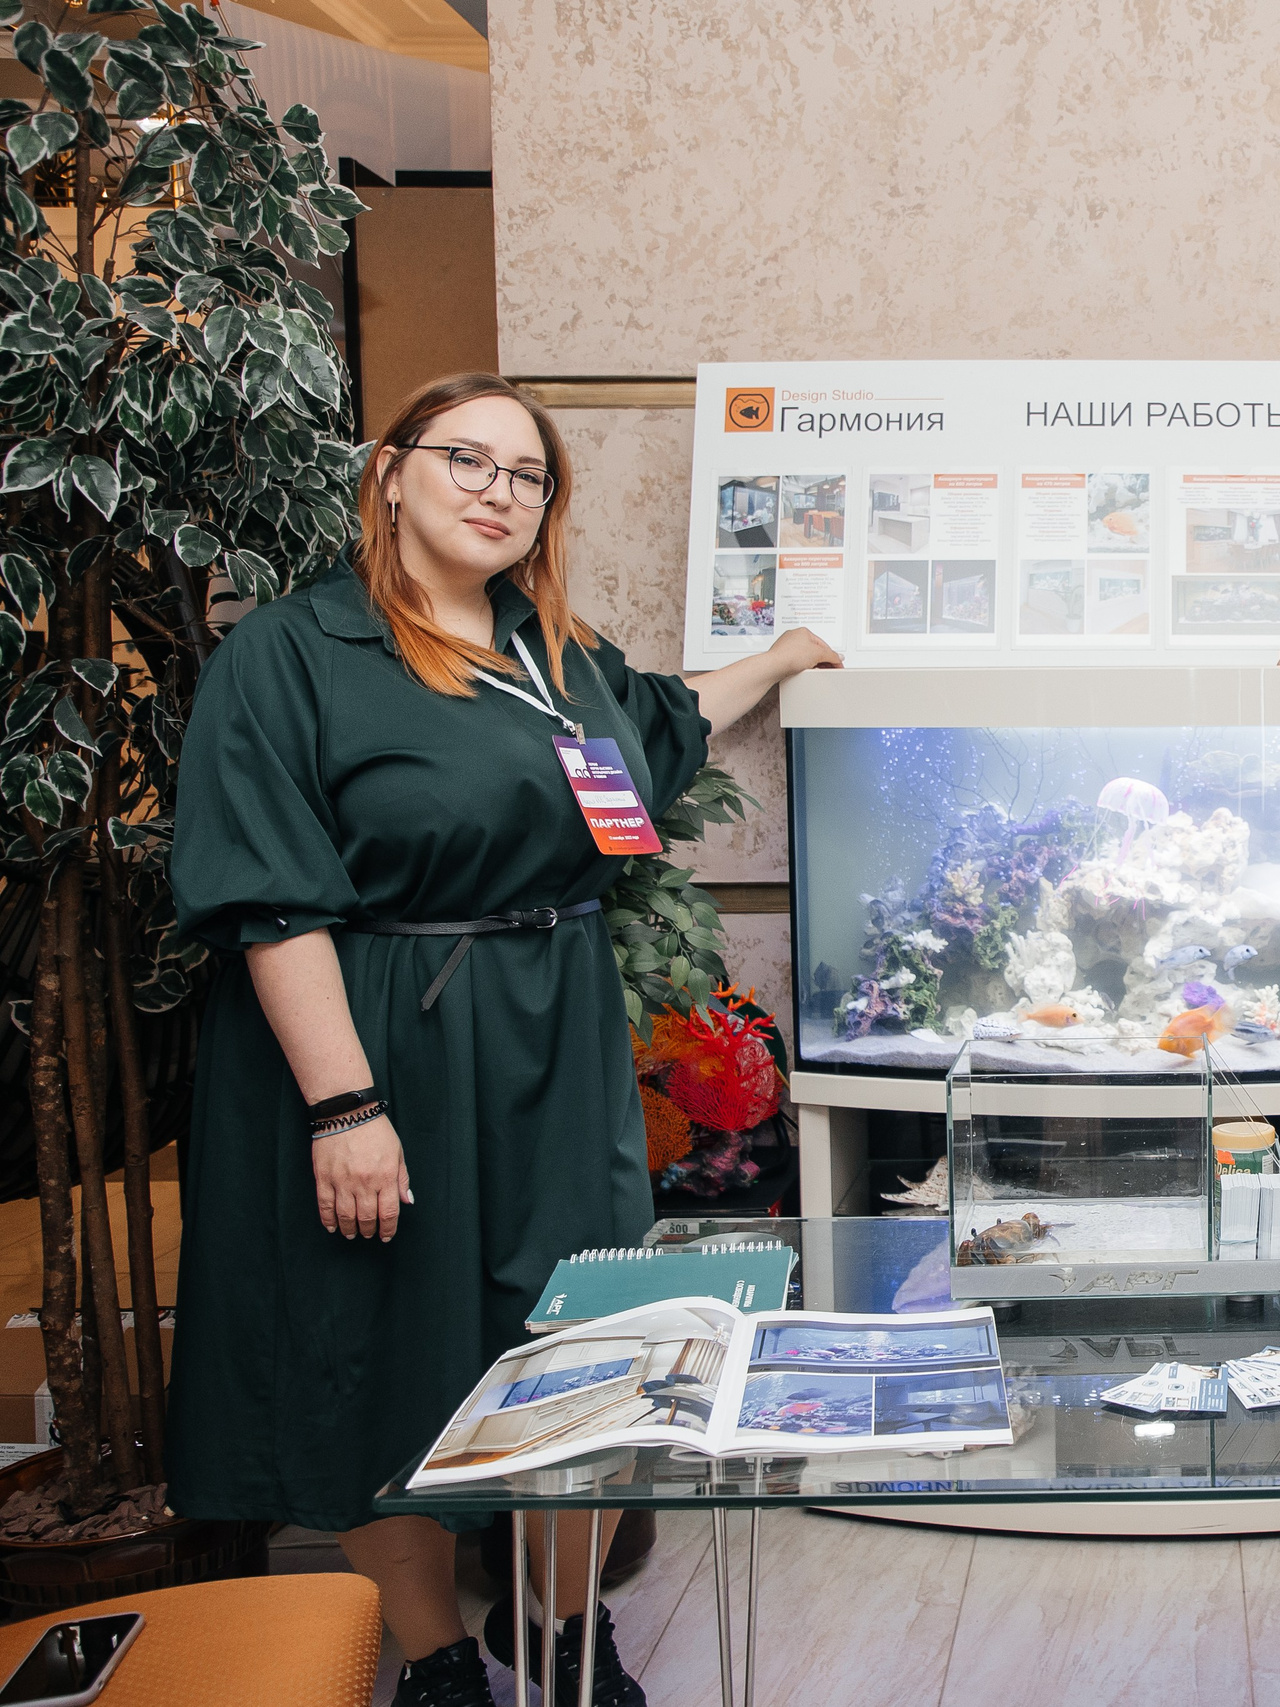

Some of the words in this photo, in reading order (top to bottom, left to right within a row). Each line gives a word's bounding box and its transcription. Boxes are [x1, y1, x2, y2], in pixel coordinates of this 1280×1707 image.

[781, 389, 827, 403] Design
[831, 388, 874, 401] Studio
[1025, 401, 1133, 427] НАШИ
[780, 406, 945, 439] Гармония
[590, 817, 645, 829] ПАРТНЕР
[1216, 1162, 1252, 1176] Delica
